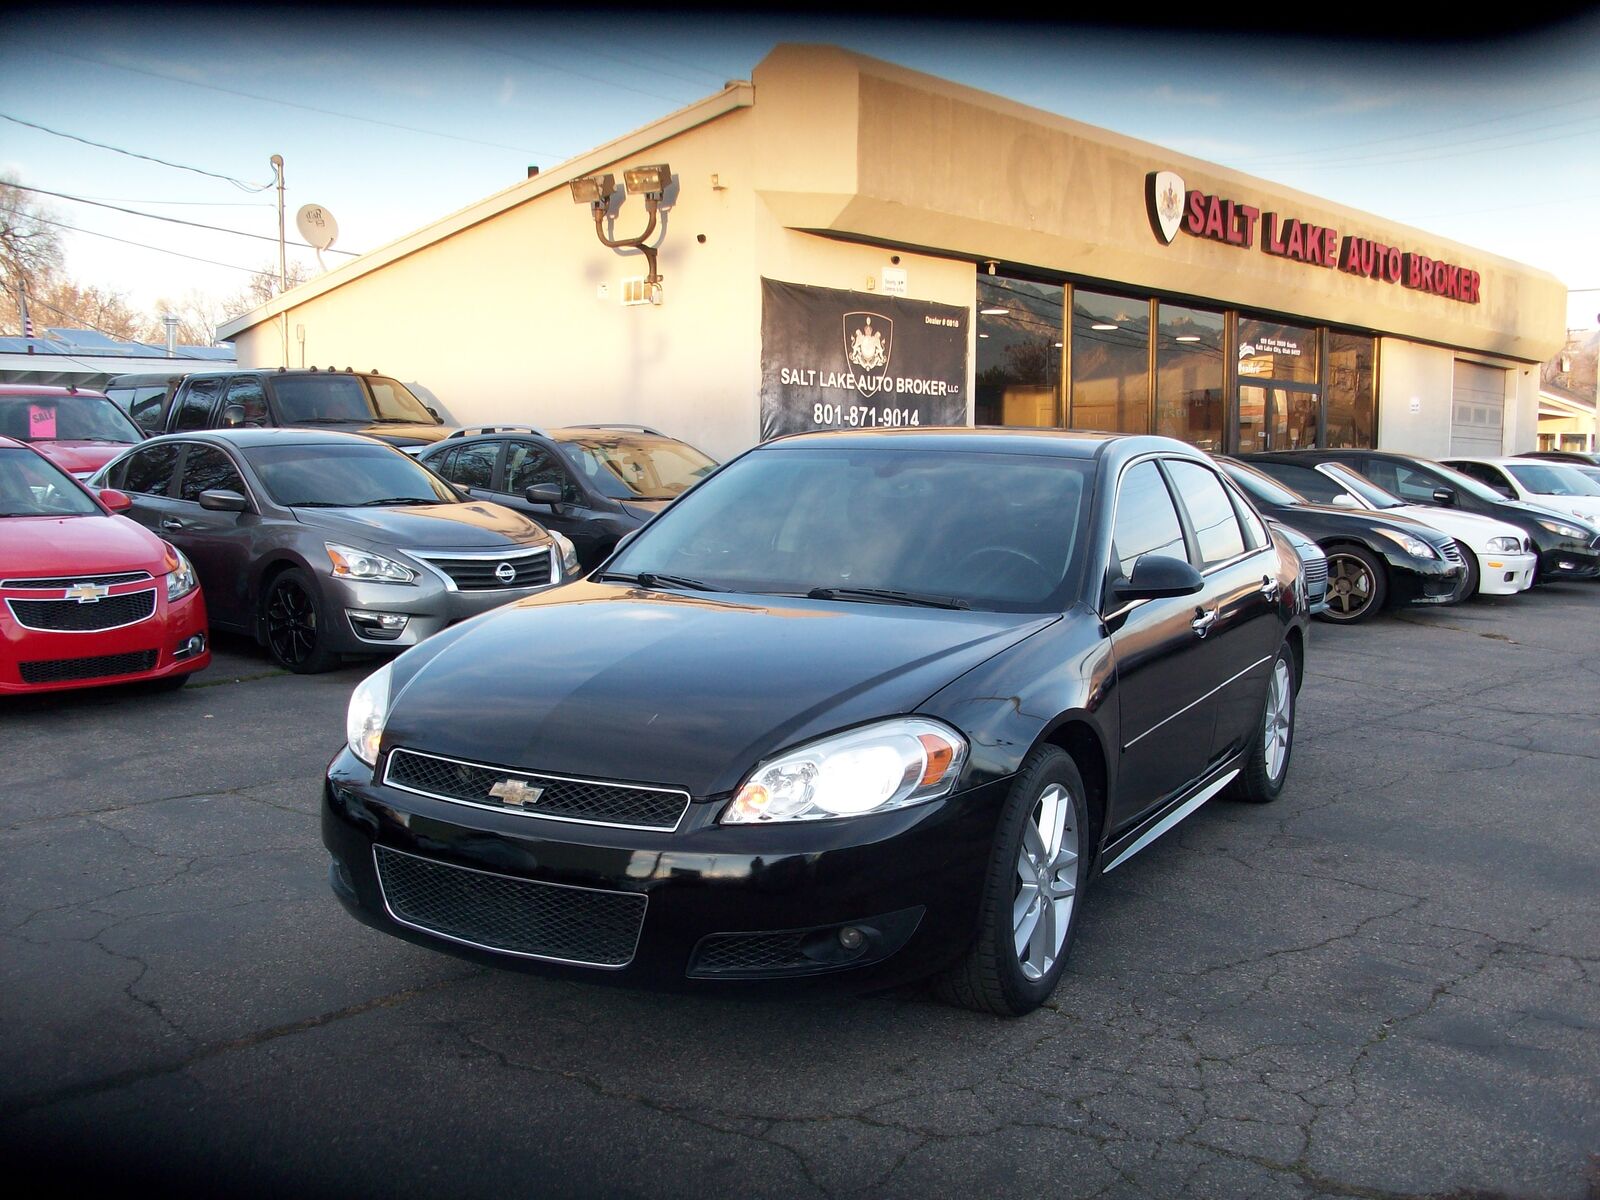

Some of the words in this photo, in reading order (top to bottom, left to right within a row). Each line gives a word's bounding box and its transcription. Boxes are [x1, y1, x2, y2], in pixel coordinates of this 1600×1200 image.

[1187, 189, 1259, 246] SALT
[1269, 212, 1338, 266] LAKE
[1346, 235, 1402, 282] AUTO
[1409, 252, 1481, 304] BROKER
[780, 367, 816, 386] SALT
[819, 370, 855, 390] LAKE
[858, 374, 893, 393] AUTO
[896, 378, 947, 396] BROKER
[947, 384, 959, 393] LLC
[813, 403, 920, 427] 801-871-9014
